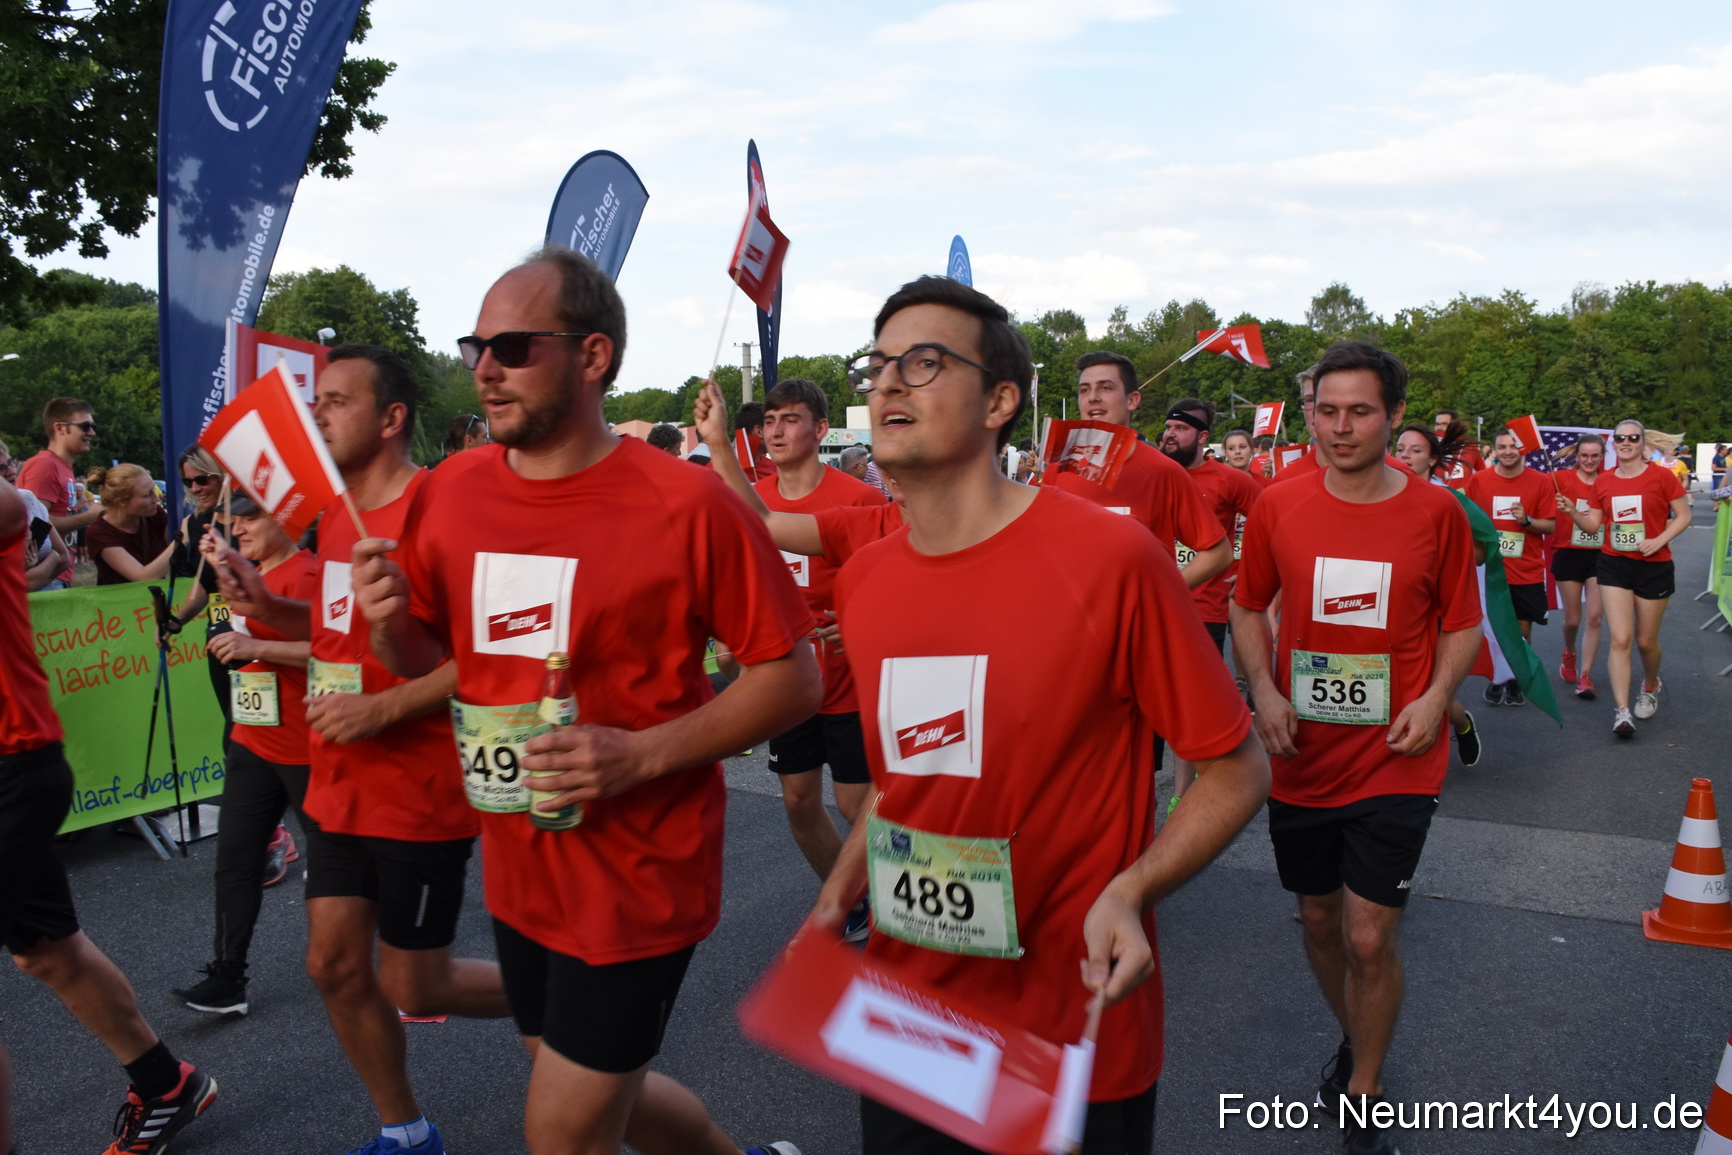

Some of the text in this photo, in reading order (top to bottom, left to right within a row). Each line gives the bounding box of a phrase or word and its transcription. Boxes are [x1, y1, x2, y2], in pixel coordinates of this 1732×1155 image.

[274, 0, 317, 95] AUTOMO
[579, 182, 615, 259] Fischer
[593, 197, 620, 261] AUTOMOBILE
[1615, 534, 1636, 544] 538
[1337, 598, 1363, 610] DEHN
[55, 650, 151, 695] laufen
[238, 691, 262, 711] 480
[1311, 677, 1367, 705] 536
[1308, 702, 1371, 713] Scherer Matthias
[913, 724, 946, 748] DEHN
[893, 869, 975, 922] 489
